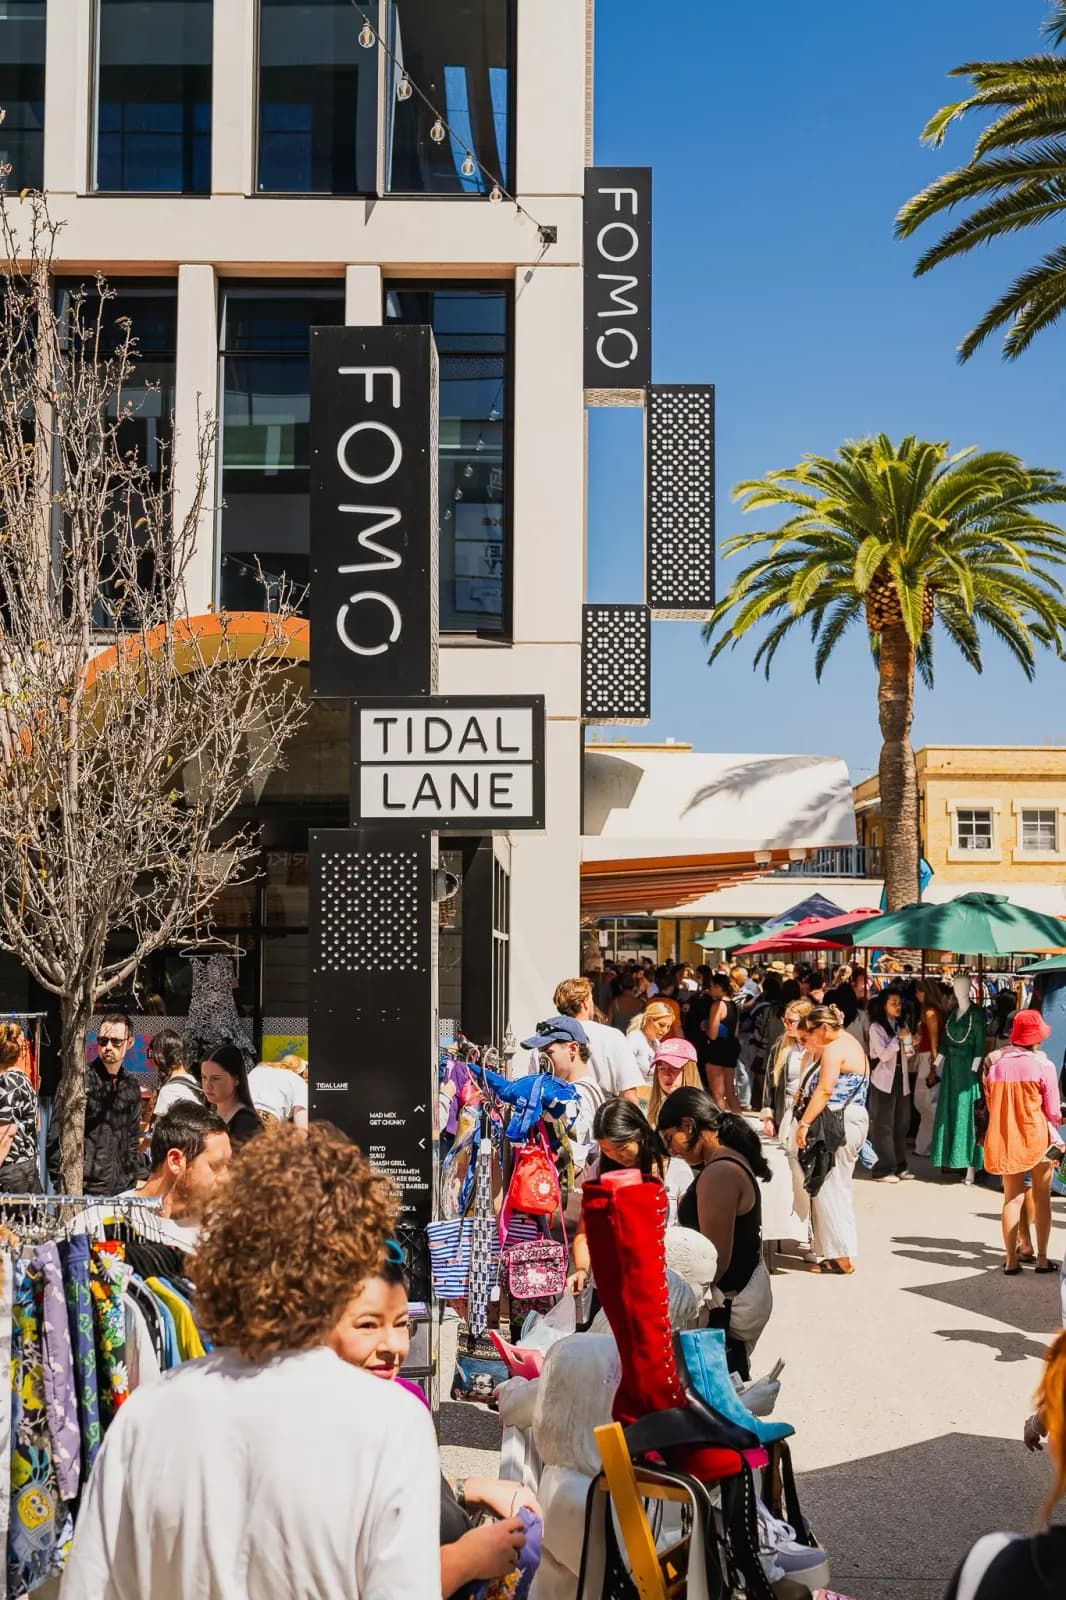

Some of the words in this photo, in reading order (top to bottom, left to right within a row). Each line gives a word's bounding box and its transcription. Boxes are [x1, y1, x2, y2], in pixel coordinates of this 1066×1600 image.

[596, 187, 640, 369] FOMO
[336, 365, 403, 656] FOMO
[373, 716, 520, 755] TIDAL
[383, 772, 513, 811] LANE
